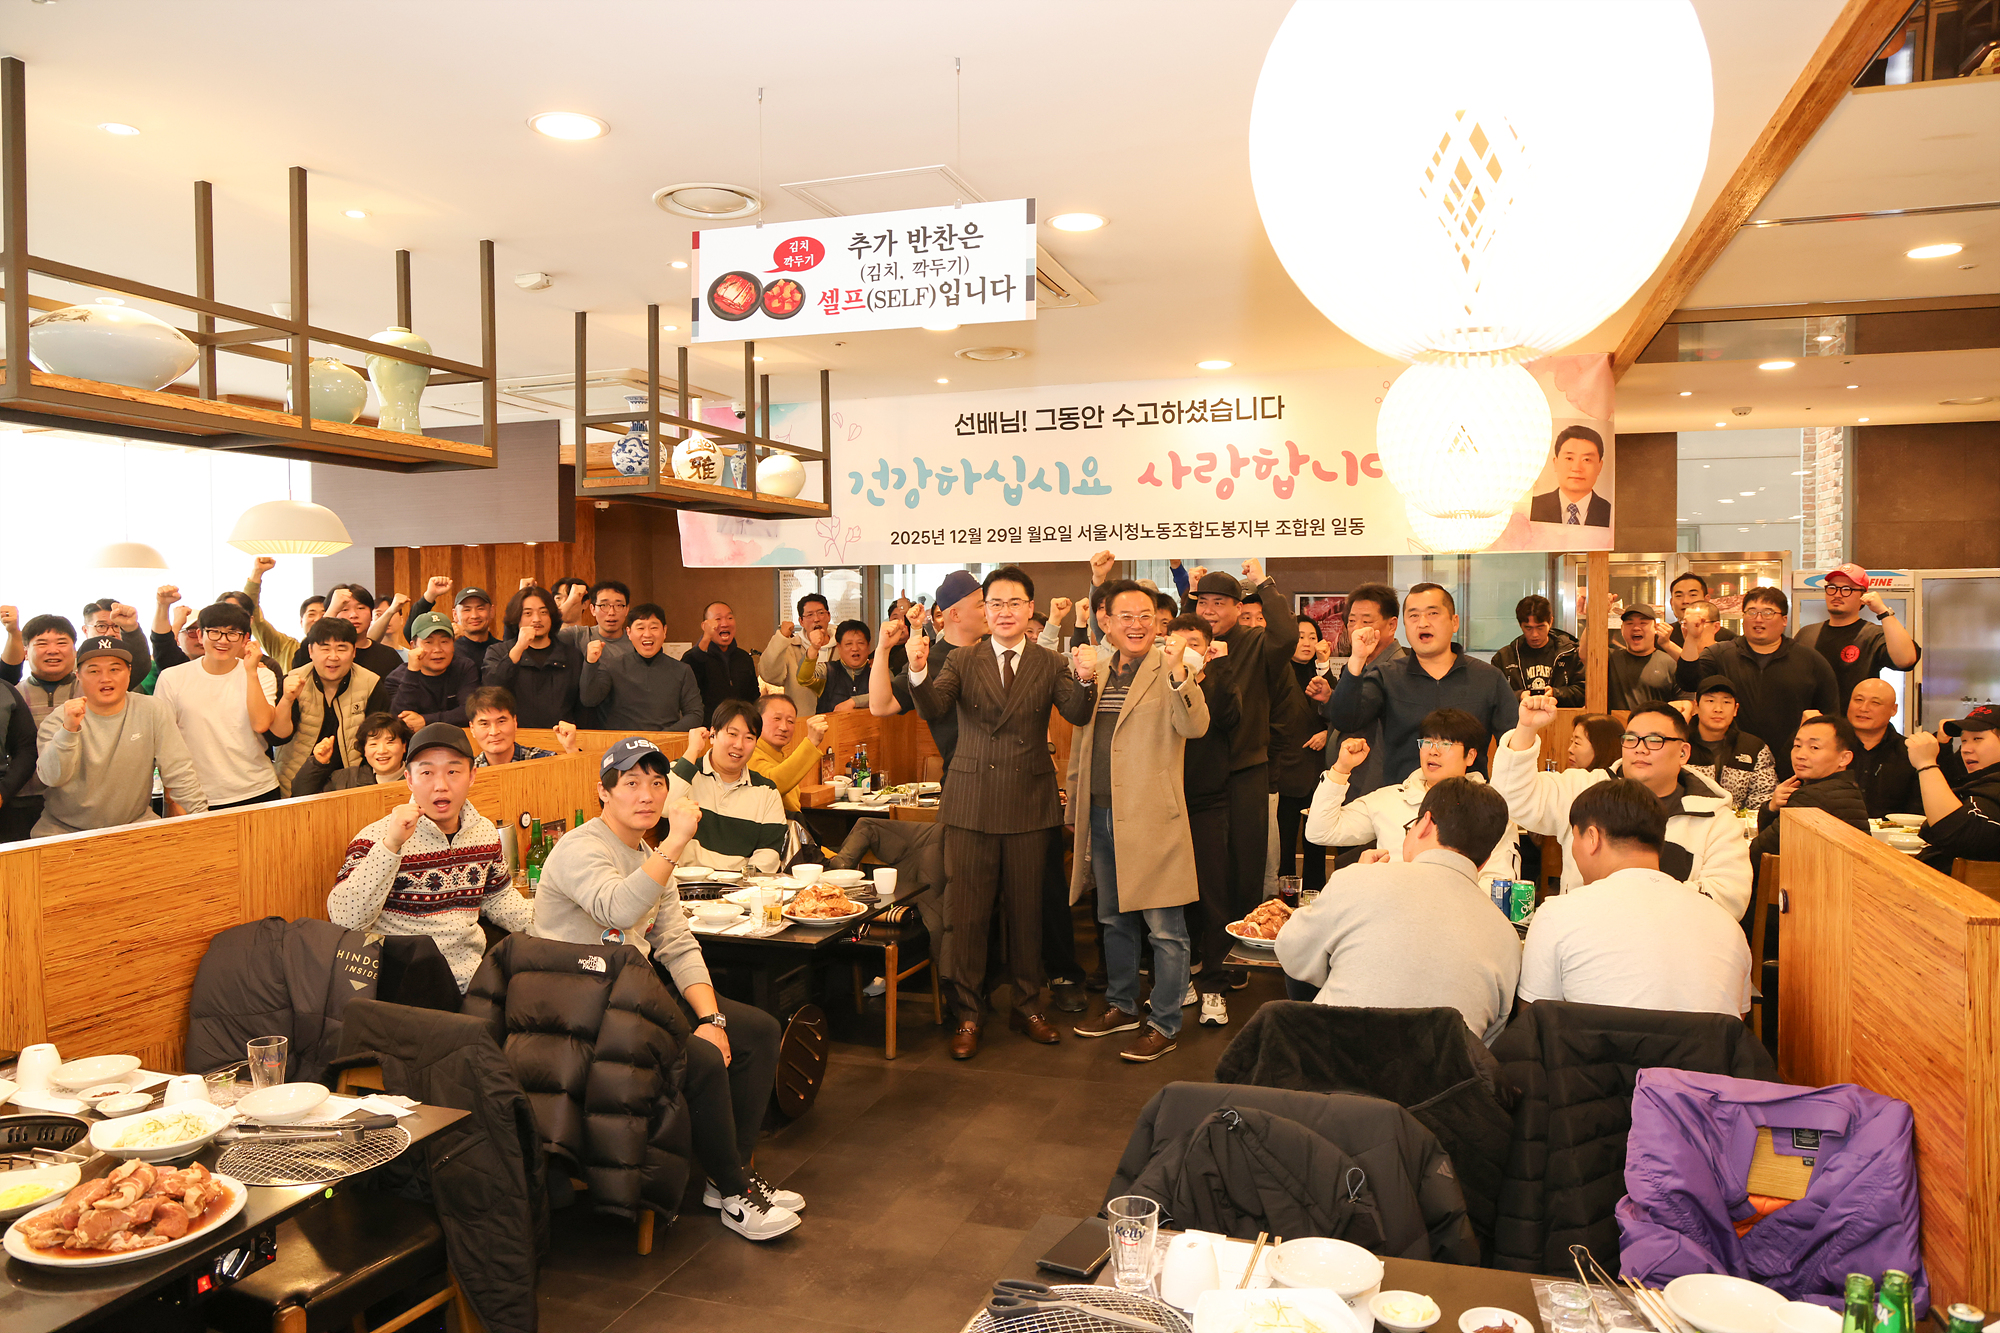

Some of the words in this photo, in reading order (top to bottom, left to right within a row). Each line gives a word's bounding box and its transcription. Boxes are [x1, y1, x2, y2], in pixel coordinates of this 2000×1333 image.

[788, 239, 809, 252] 김치
[847, 229, 899, 260] 추가
[907, 221, 985, 254] 반찬은
[783, 253, 815, 268] 깍두기
[912, 256, 970, 279] 깍두기)
[817, 275, 1016, 315] 셀프(SELF)입니다
[954, 409, 1027, 436] 선배님!
[1035, 404, 1104, 431] 그동안
[1112, 395, 1285, 427] 수고하셨습니다
[848, 455, 1112, 508] 건강하십시요
[890, 529, 945, 545] 2025년
[949, 528, 982, 544] 12월
[986, 526, 1022, 543] 29일
[1027, 525, 1072, 542] 월요일
[1077, 520, 1271, 542] 서울시청노동조합도봉지부
[1275, 519, 1325, 537] 조합원
[1331, 517, 1366, 535] 일동
[98, 639, 112, 649] NY
[626, 739, 660, 752] USA
[344, 964, 378, 980] INSIDE
[1115, 1225, 1146, 1241] Kelly
